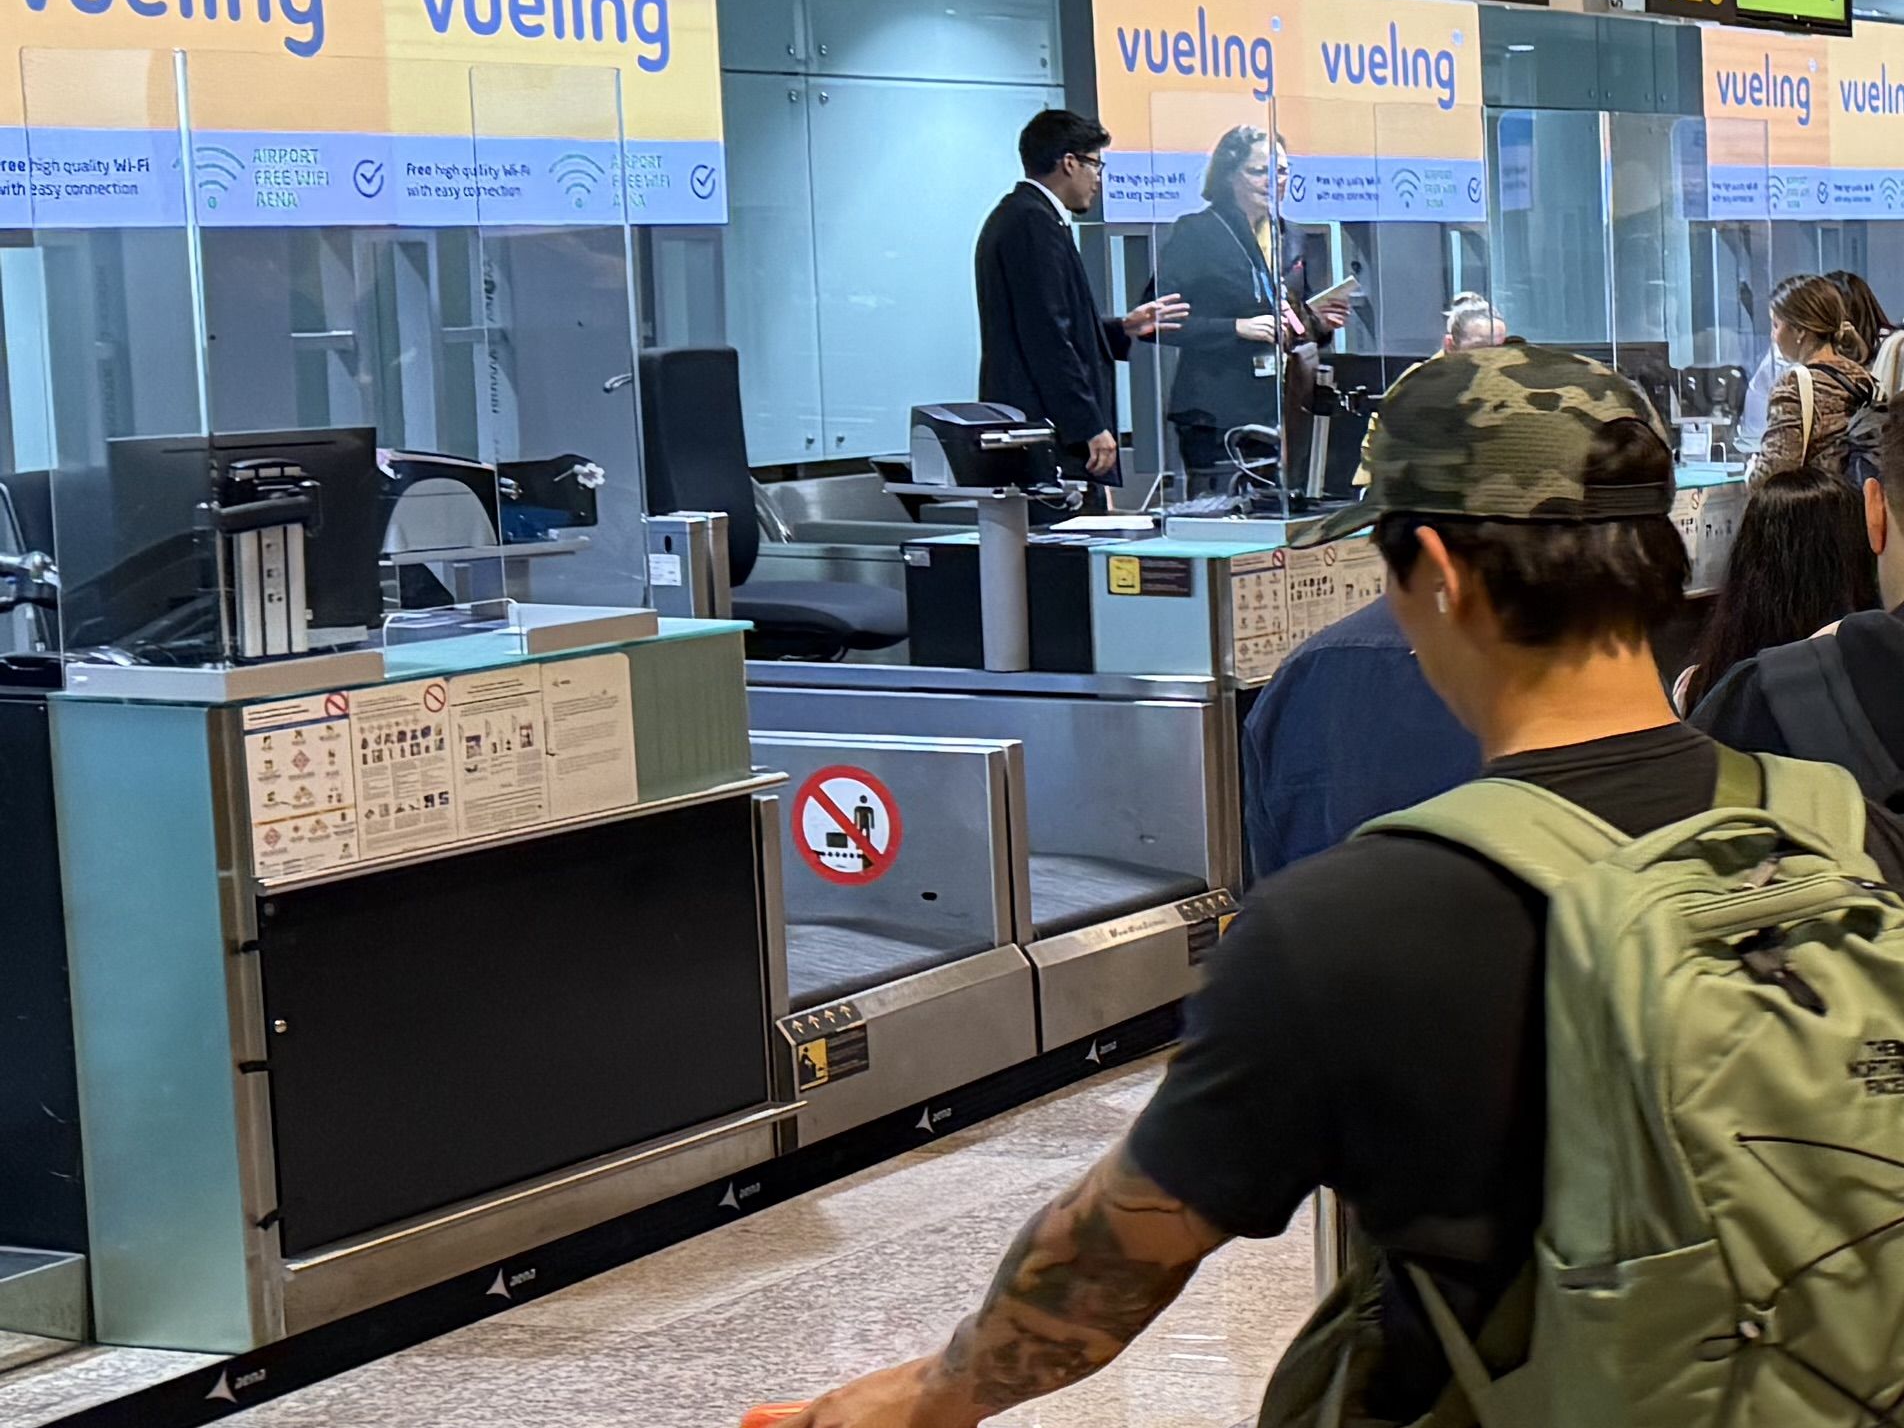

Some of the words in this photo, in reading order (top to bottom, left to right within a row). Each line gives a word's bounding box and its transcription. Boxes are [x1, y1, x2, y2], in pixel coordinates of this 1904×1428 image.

[1117, 7, 1273, 102] vueling
[1322, 22, 1455, 110] vueling
[1717, 53, 1812, 126] vueling
[0, 161, 26, 172] ree
